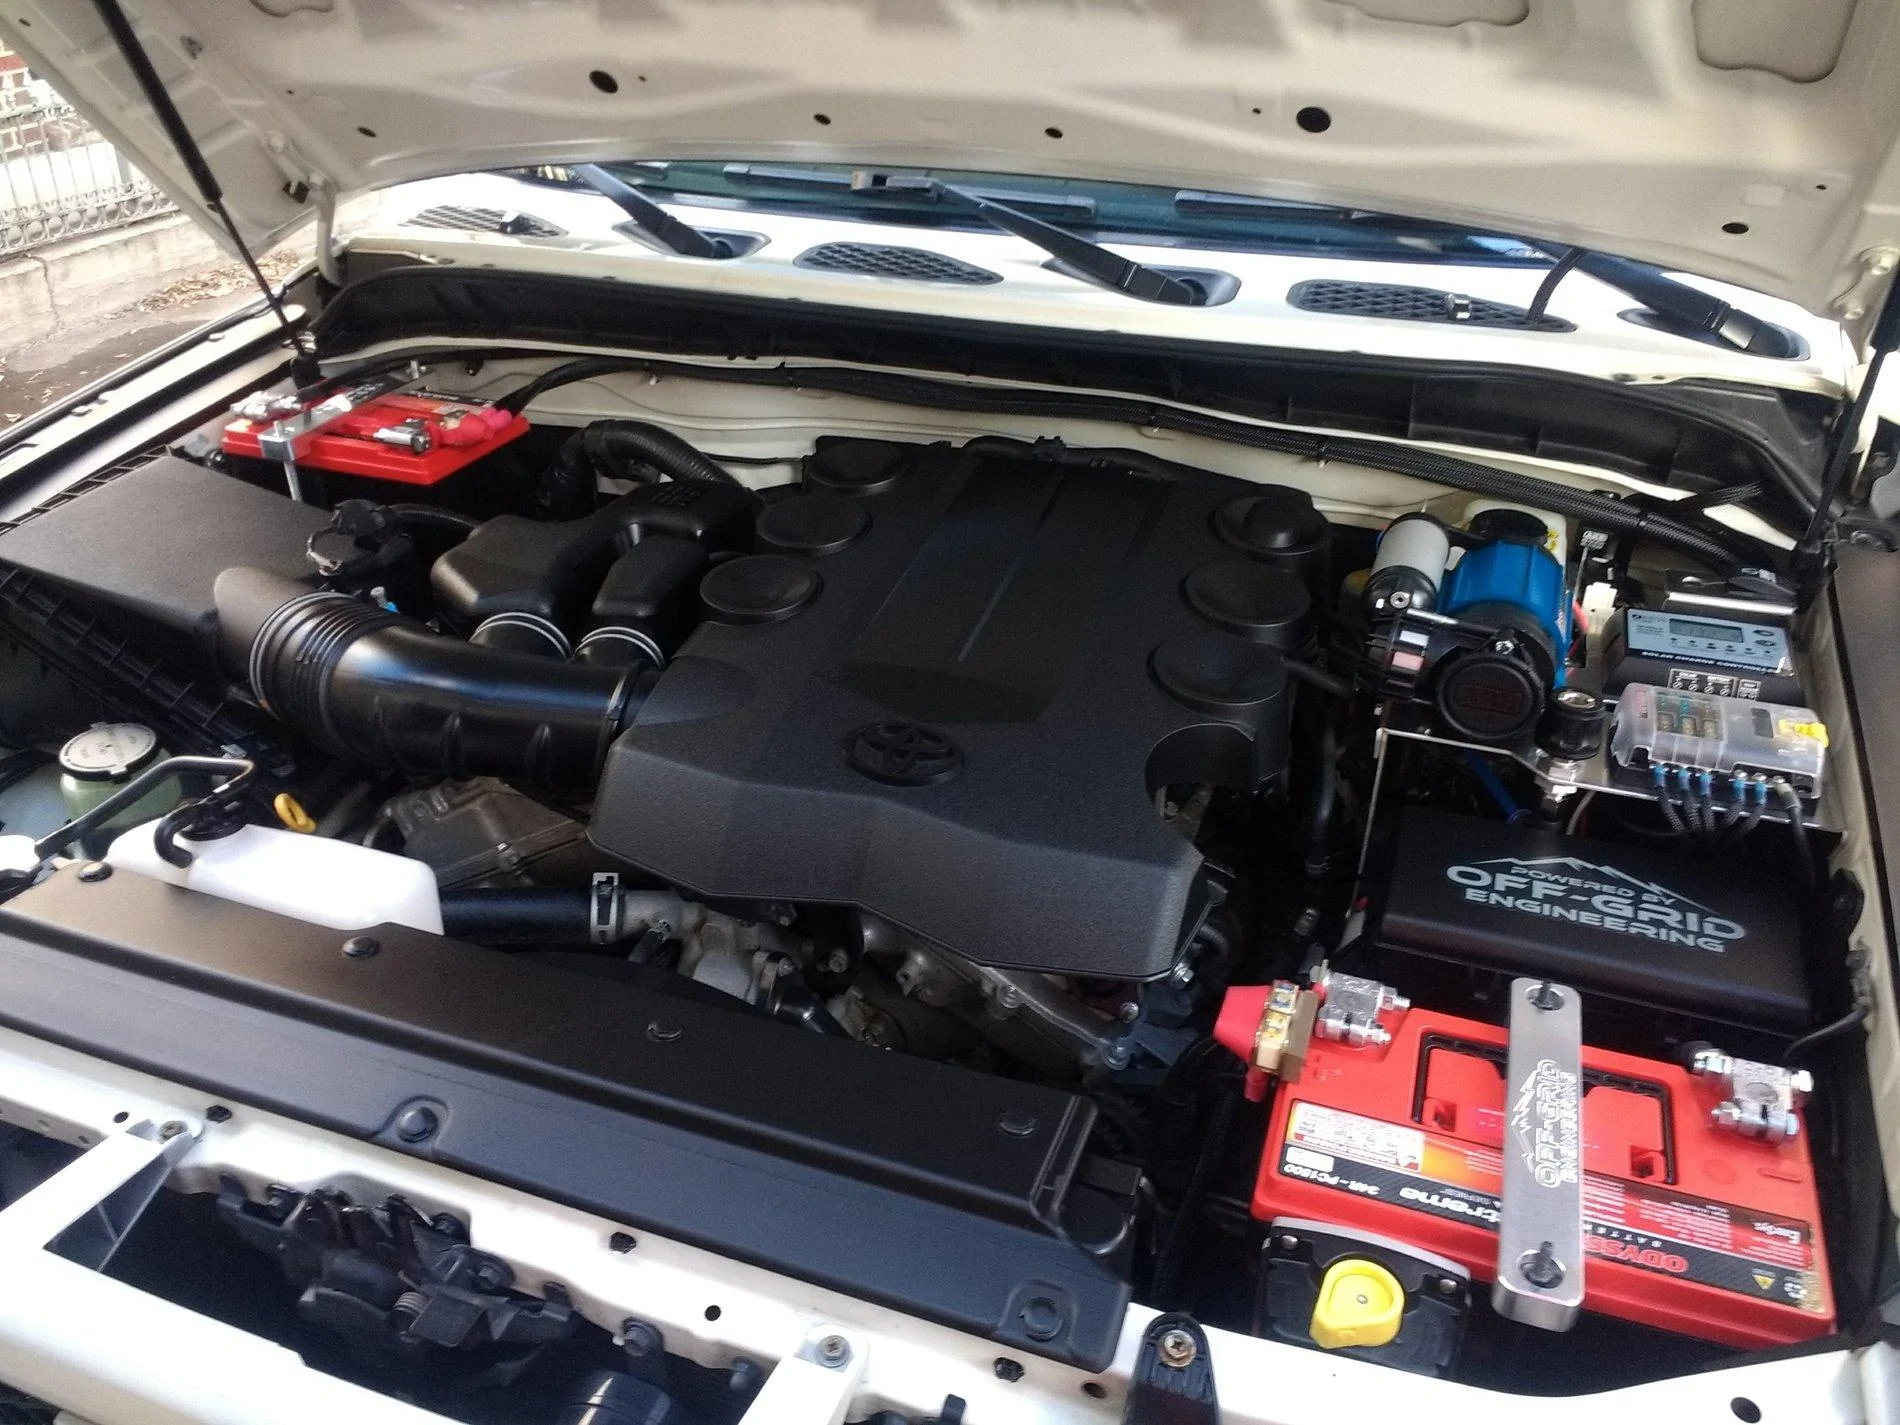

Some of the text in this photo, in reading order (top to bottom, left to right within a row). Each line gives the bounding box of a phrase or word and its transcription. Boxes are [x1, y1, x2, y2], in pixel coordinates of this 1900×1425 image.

[1446, 865, 1746, 940] OFF-GRID
[1510, 866, 1676, 905] POWERED BY
[1465, 888, 1726, 953] ENGINEERING
[1399, 1187, 1502, 1224] treme
[1583, 1221, 1662, 1248] BATTER
[1583, 1235, 1689, 1273] ODYSS
